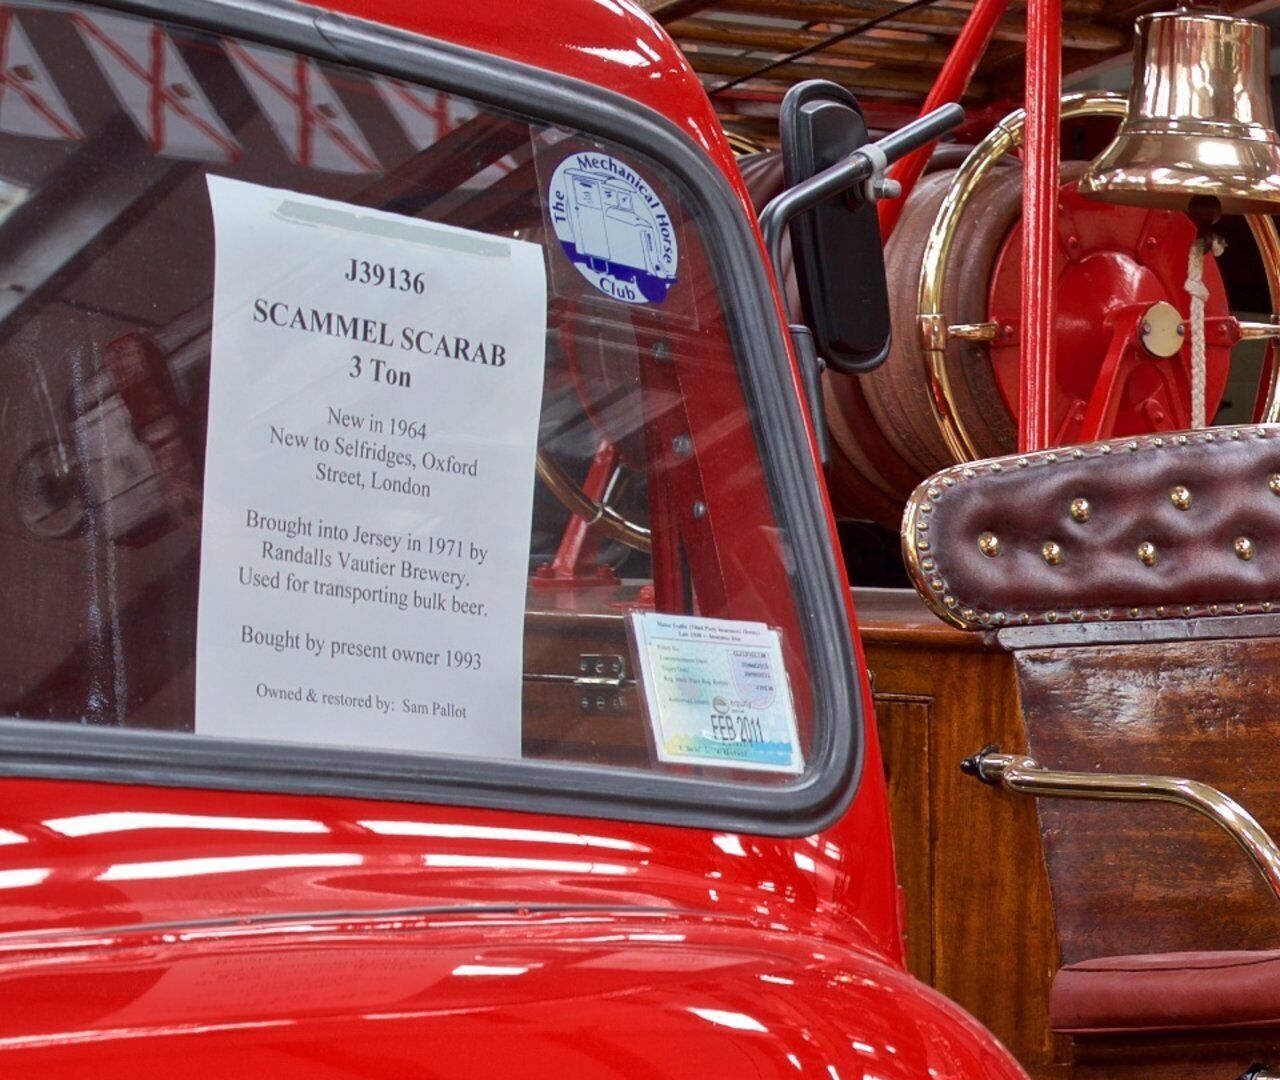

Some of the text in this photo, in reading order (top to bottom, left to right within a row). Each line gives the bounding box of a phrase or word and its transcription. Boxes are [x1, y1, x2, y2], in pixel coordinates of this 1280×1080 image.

[552, 155, 673, 264] The Mechanical Horse
[345, 258, 425, 295] J39136
[600, 277, 636, 301] Club
[252, 299, 506, 367] SCAMMEL SCARAB
[349, 355, 411, 388] 3 Ton
[328, 407, 427, 440] New in 1964
[270, 426, 478, 477] New to Selfridges, Oxford
[315, 462, 431, 498] Street, London
[246, 509, 488, 565] Brought into Jersey in 1971 by
[261, 541, 470, 590] Randalls Vautier Brewery.
[238, 566, 488, 617] Used for transporting bulk beer.
[240, 625, 482, 671] Bought by present owner 1993
[256, 683, 466, 719] Owned & restored by: Sam Pallot
[711, 714, 764, 743] FEB 2011
